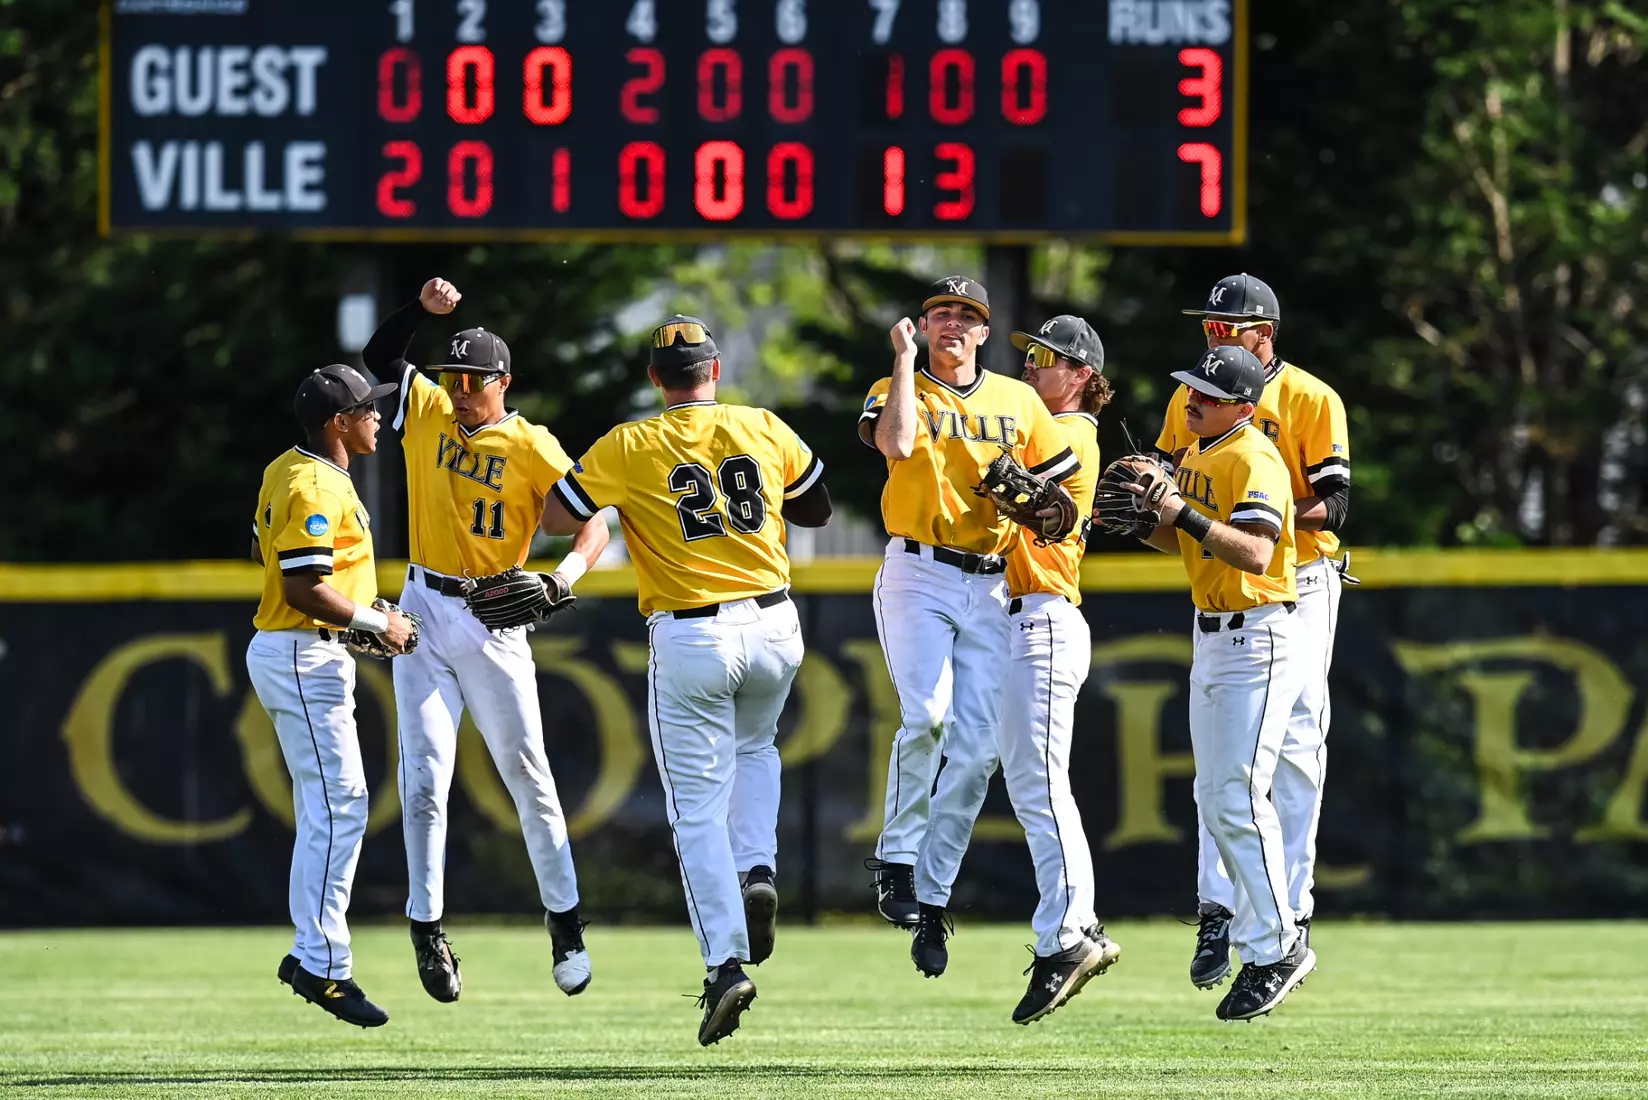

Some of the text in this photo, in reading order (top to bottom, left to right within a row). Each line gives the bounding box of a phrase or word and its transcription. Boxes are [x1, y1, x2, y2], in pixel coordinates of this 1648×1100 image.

[389, 0, 1231, 45] 1 2 3 4 5 6 7 8 9 RUNS
[130, 45, 1223, 127] GUEST 0 0 0 2 0 0 1 0 0 3
[131, 140, 1223, 220] VILLE 2 0 1 0 0 0 1 3 7
[946, 279, 969, 296] M
[450, 339, 471, 360] M
[922, 408, 1016, 450] VILLE
[436, 432, 507, 493] VILLE
[667, 453, 767, 542] 28
[1247, 490, 1270, 501] PSAC
[470, 497, 505, 540] 11
[484, 586, 510, 598] A2000
